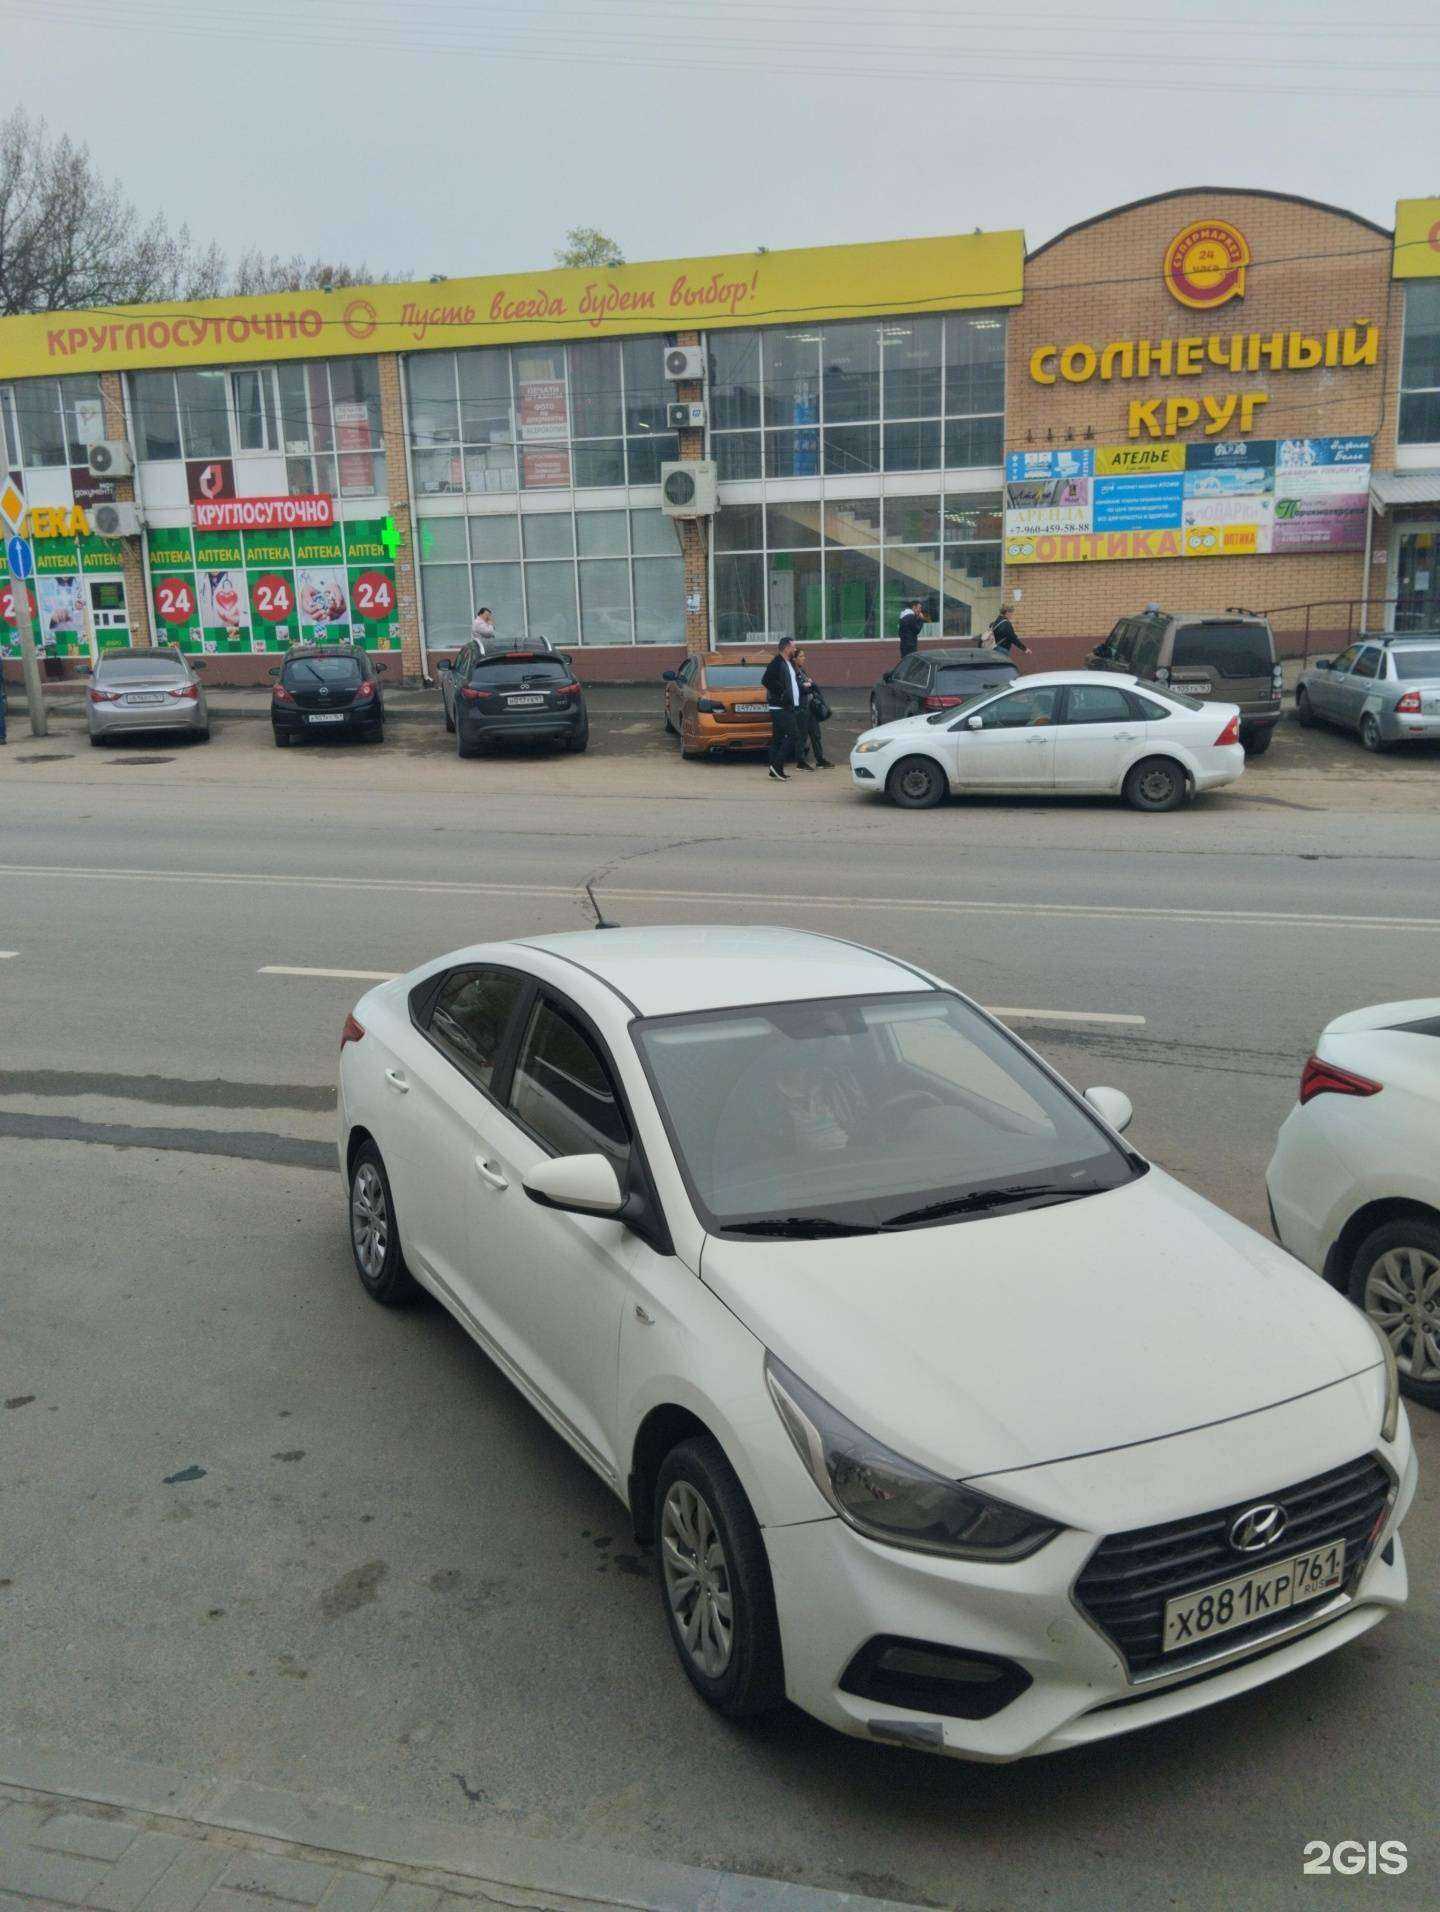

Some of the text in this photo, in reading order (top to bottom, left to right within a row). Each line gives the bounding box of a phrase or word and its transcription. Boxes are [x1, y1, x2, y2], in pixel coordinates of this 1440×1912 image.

[1173, 229, 1241, 269] СУПЕРМАРКЕТ
[1199, 250, 1214, 260] 24
[400, 270, 759, 341] Пусть всегда будет выбор!
[47, 309, 324, 357] КРУГЛОСУТОЧНО
[1030, 318, 1379, 385] СОЛНЕЧНЫЙ
[1128, 393, 1270, 439] КРУГ
[1112, 449, 1169, 466] АТЕЛЬЕ
[197, 501, 330, 526] КРУГЛОСУТОЧНО
[150, 550, 191, 563] АПТЕКА
[198, 548, 240, 562] АПТЕКА
[247, 547, 290, 561] АПТЕКА
[298, 545, 342, 559] АПТЕКА
[349, 544, 385, 557] АПТЕК
[1035, 531, 1178, 561] ОПТИКА
[38, 555, 78, 568] АПТЕКА
[159, 588, 191, 613] 24
[257, 585, 289, 611] 24
[358, 584, 390, 608] 24
[1174, 1548, 1338, 1641] Х881КР 761
[1303, 1580, 1326, 1595] RUS
